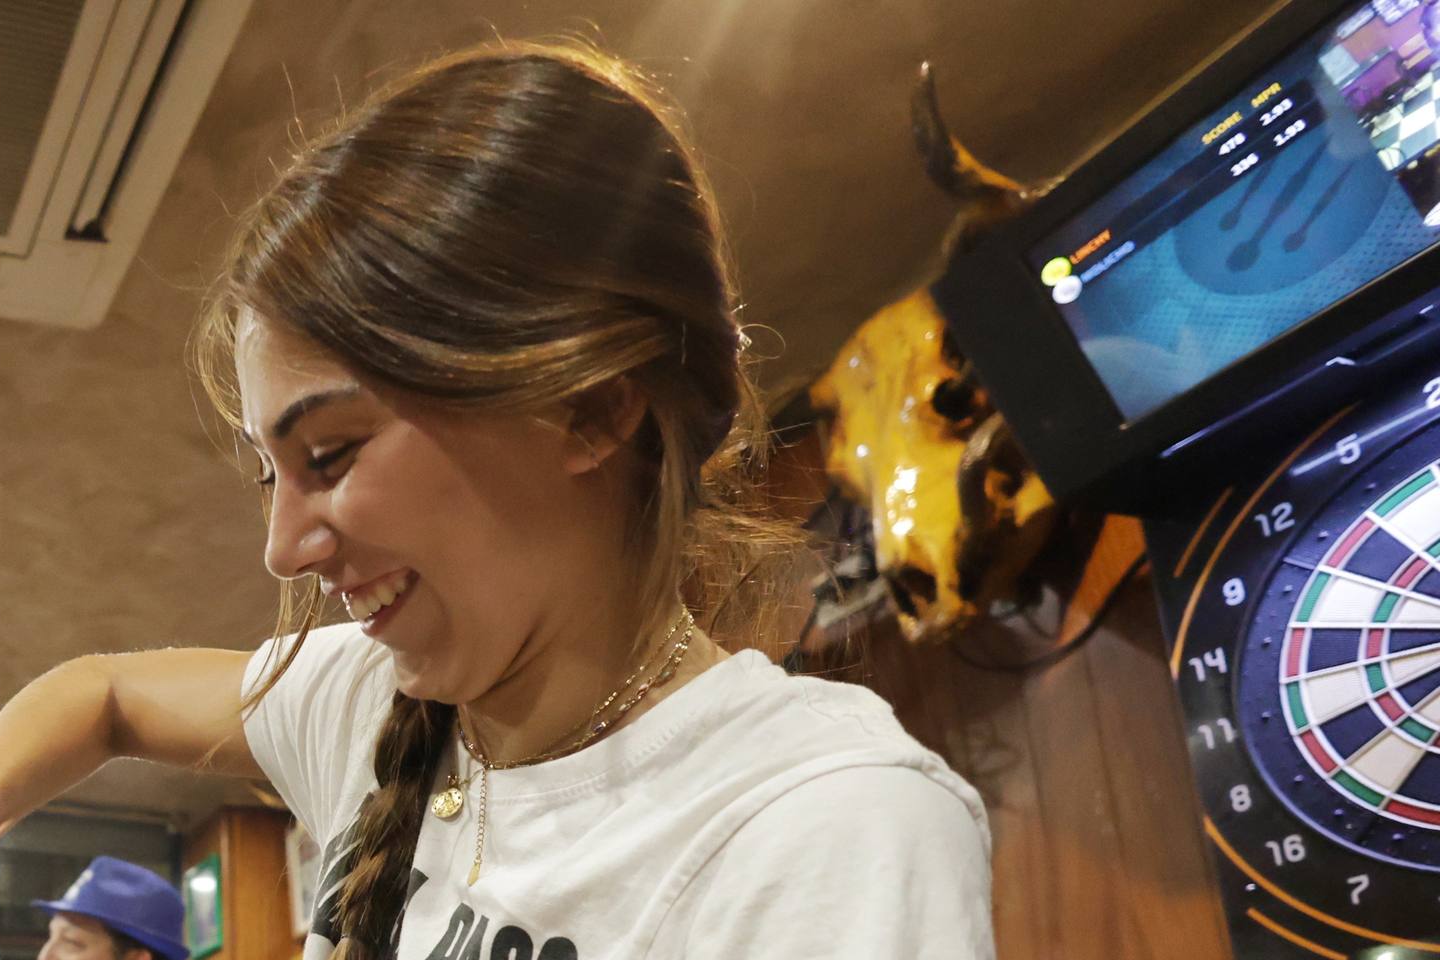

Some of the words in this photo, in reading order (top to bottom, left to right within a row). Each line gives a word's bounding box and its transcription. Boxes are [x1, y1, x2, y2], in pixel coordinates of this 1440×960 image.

[1336, 433, 1361, 464] 5
[1254, 502, 1295, 536] 12
[1222, 577, 1246, 606] 9
[1188, 646, 1227, 682] 14
[1197, 717, 1236, 749] 11
[1230, 784, 1252, 812] 8
[1265, 834, 1306, 866] 16
[1347, 873, 1370, 905] 7
